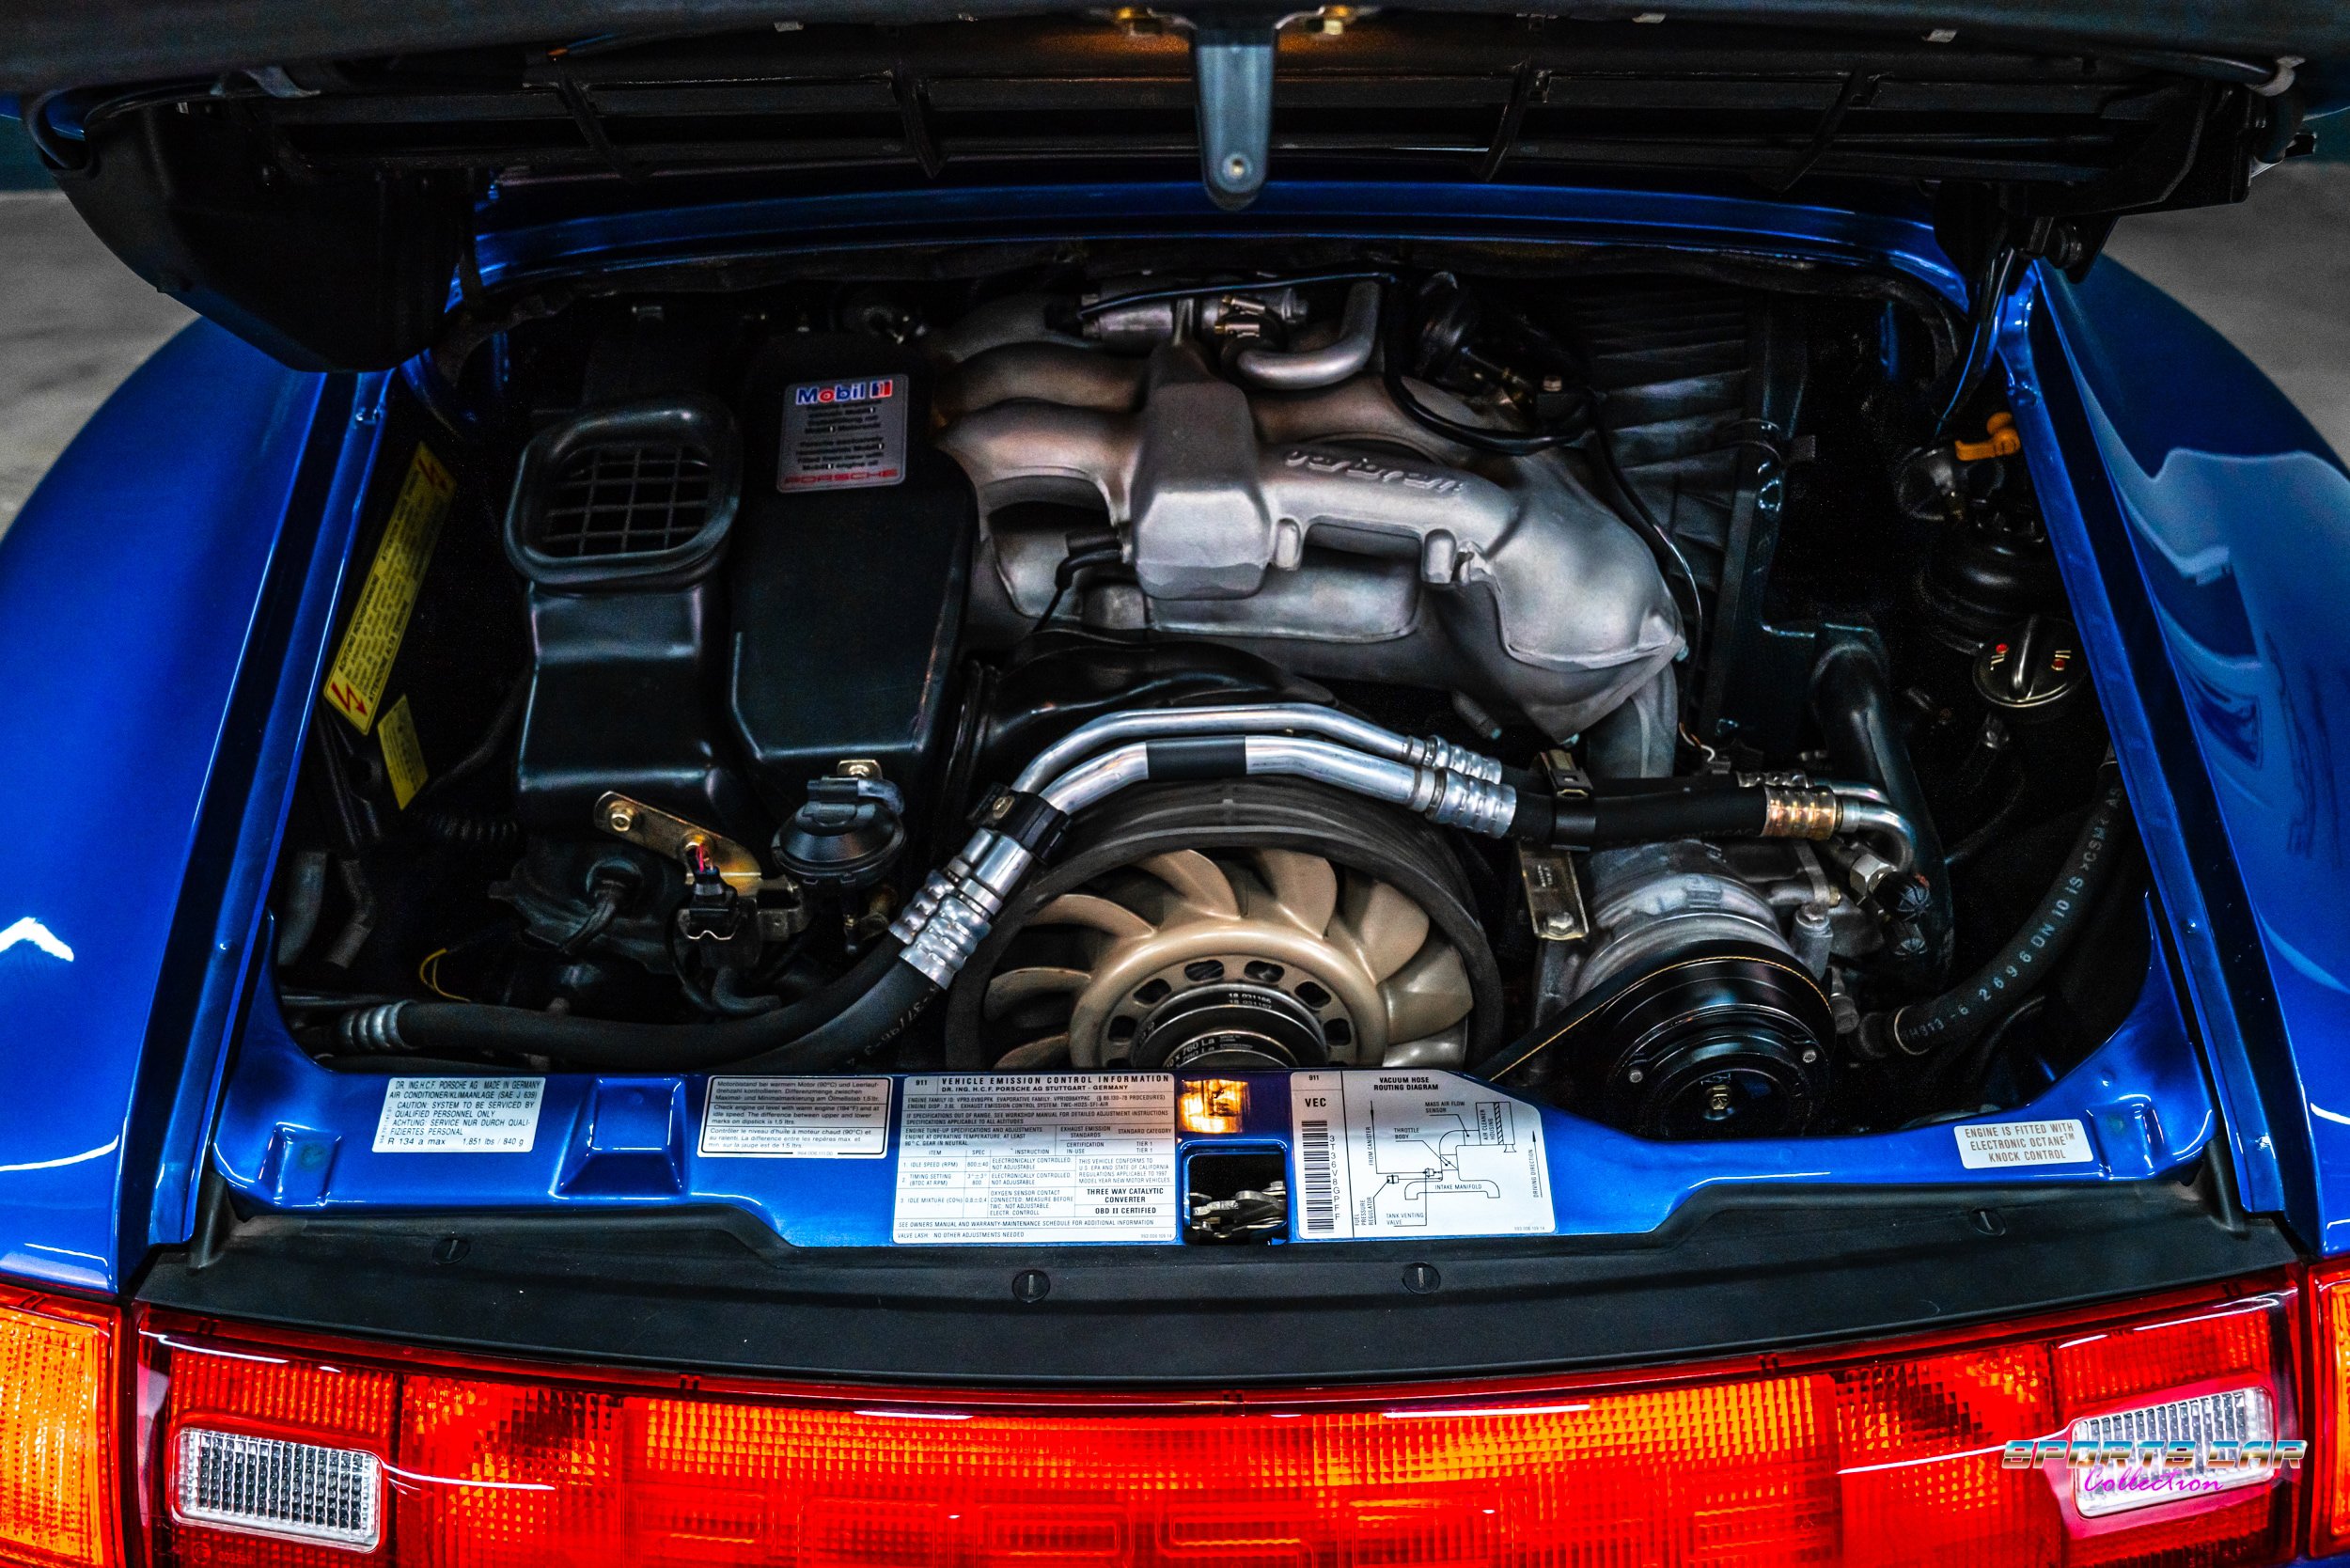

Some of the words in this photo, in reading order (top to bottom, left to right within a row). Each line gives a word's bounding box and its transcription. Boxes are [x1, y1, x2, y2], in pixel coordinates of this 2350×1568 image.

[796, 382, 866, 404] Mobil
[942, 1076, 985, 1085] VEHICLE
[1047, 1075, 1092, 1084] CONTROL
[1305, 1098, 1327, 1107] VEC
[1965, 1126, 1998, 1137] ENGINE
[2002, 1126, 2012, 1136] IS
[2015, 1124, 2047, 1135] FITTED
[2049, 1122, 2074, 1132] WITH
[1970, 1137, 2027, 1151] ELECTRONIC
[1989, 1152, 2021, 1162] KNOCK
[2025, 1149, 2066, 1161] CONTROL
